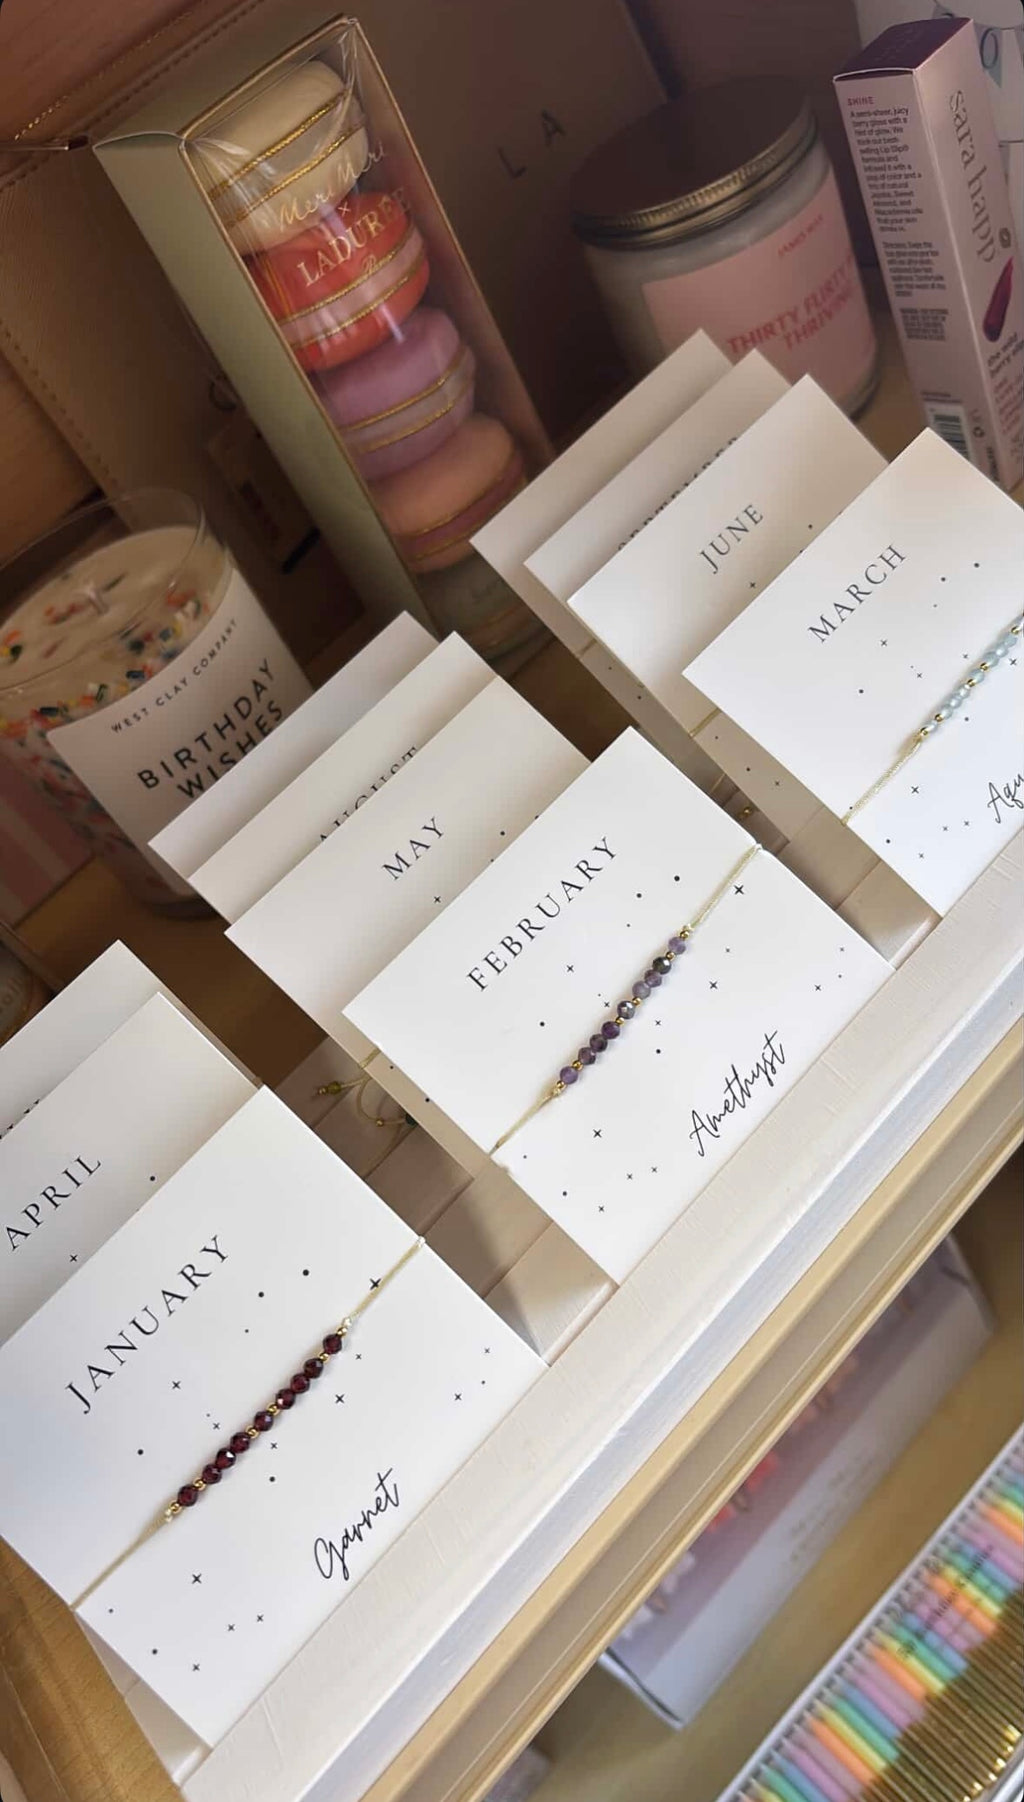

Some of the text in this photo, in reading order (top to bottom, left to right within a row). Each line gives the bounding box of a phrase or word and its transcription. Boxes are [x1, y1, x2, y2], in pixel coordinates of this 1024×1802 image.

[847, 96, 875, 106] SHINE
[949, 90, 997, 263] sara happ
[727, 304, 799, 354] THIRTY
[699, 504, 764, 574] JUNE
[807, 544, 907, 644] MARCH
[111, 618, 238, 733] WEST CLAY COMPANY
[137, 658, 275, 789] BIRTHDAY
[177, 700, 283, 799] WISHES
[382, 816, 445, 881] MAY
[466, 836, 618, 992] FEBRUARY
[689, 1030, 786, 1158] Amethyst
[3, 1154, 102, 1251] APRIL
[65, 1235, 230, 1415] JANUARY
[313, 1467, 400, 1581] Garnet
